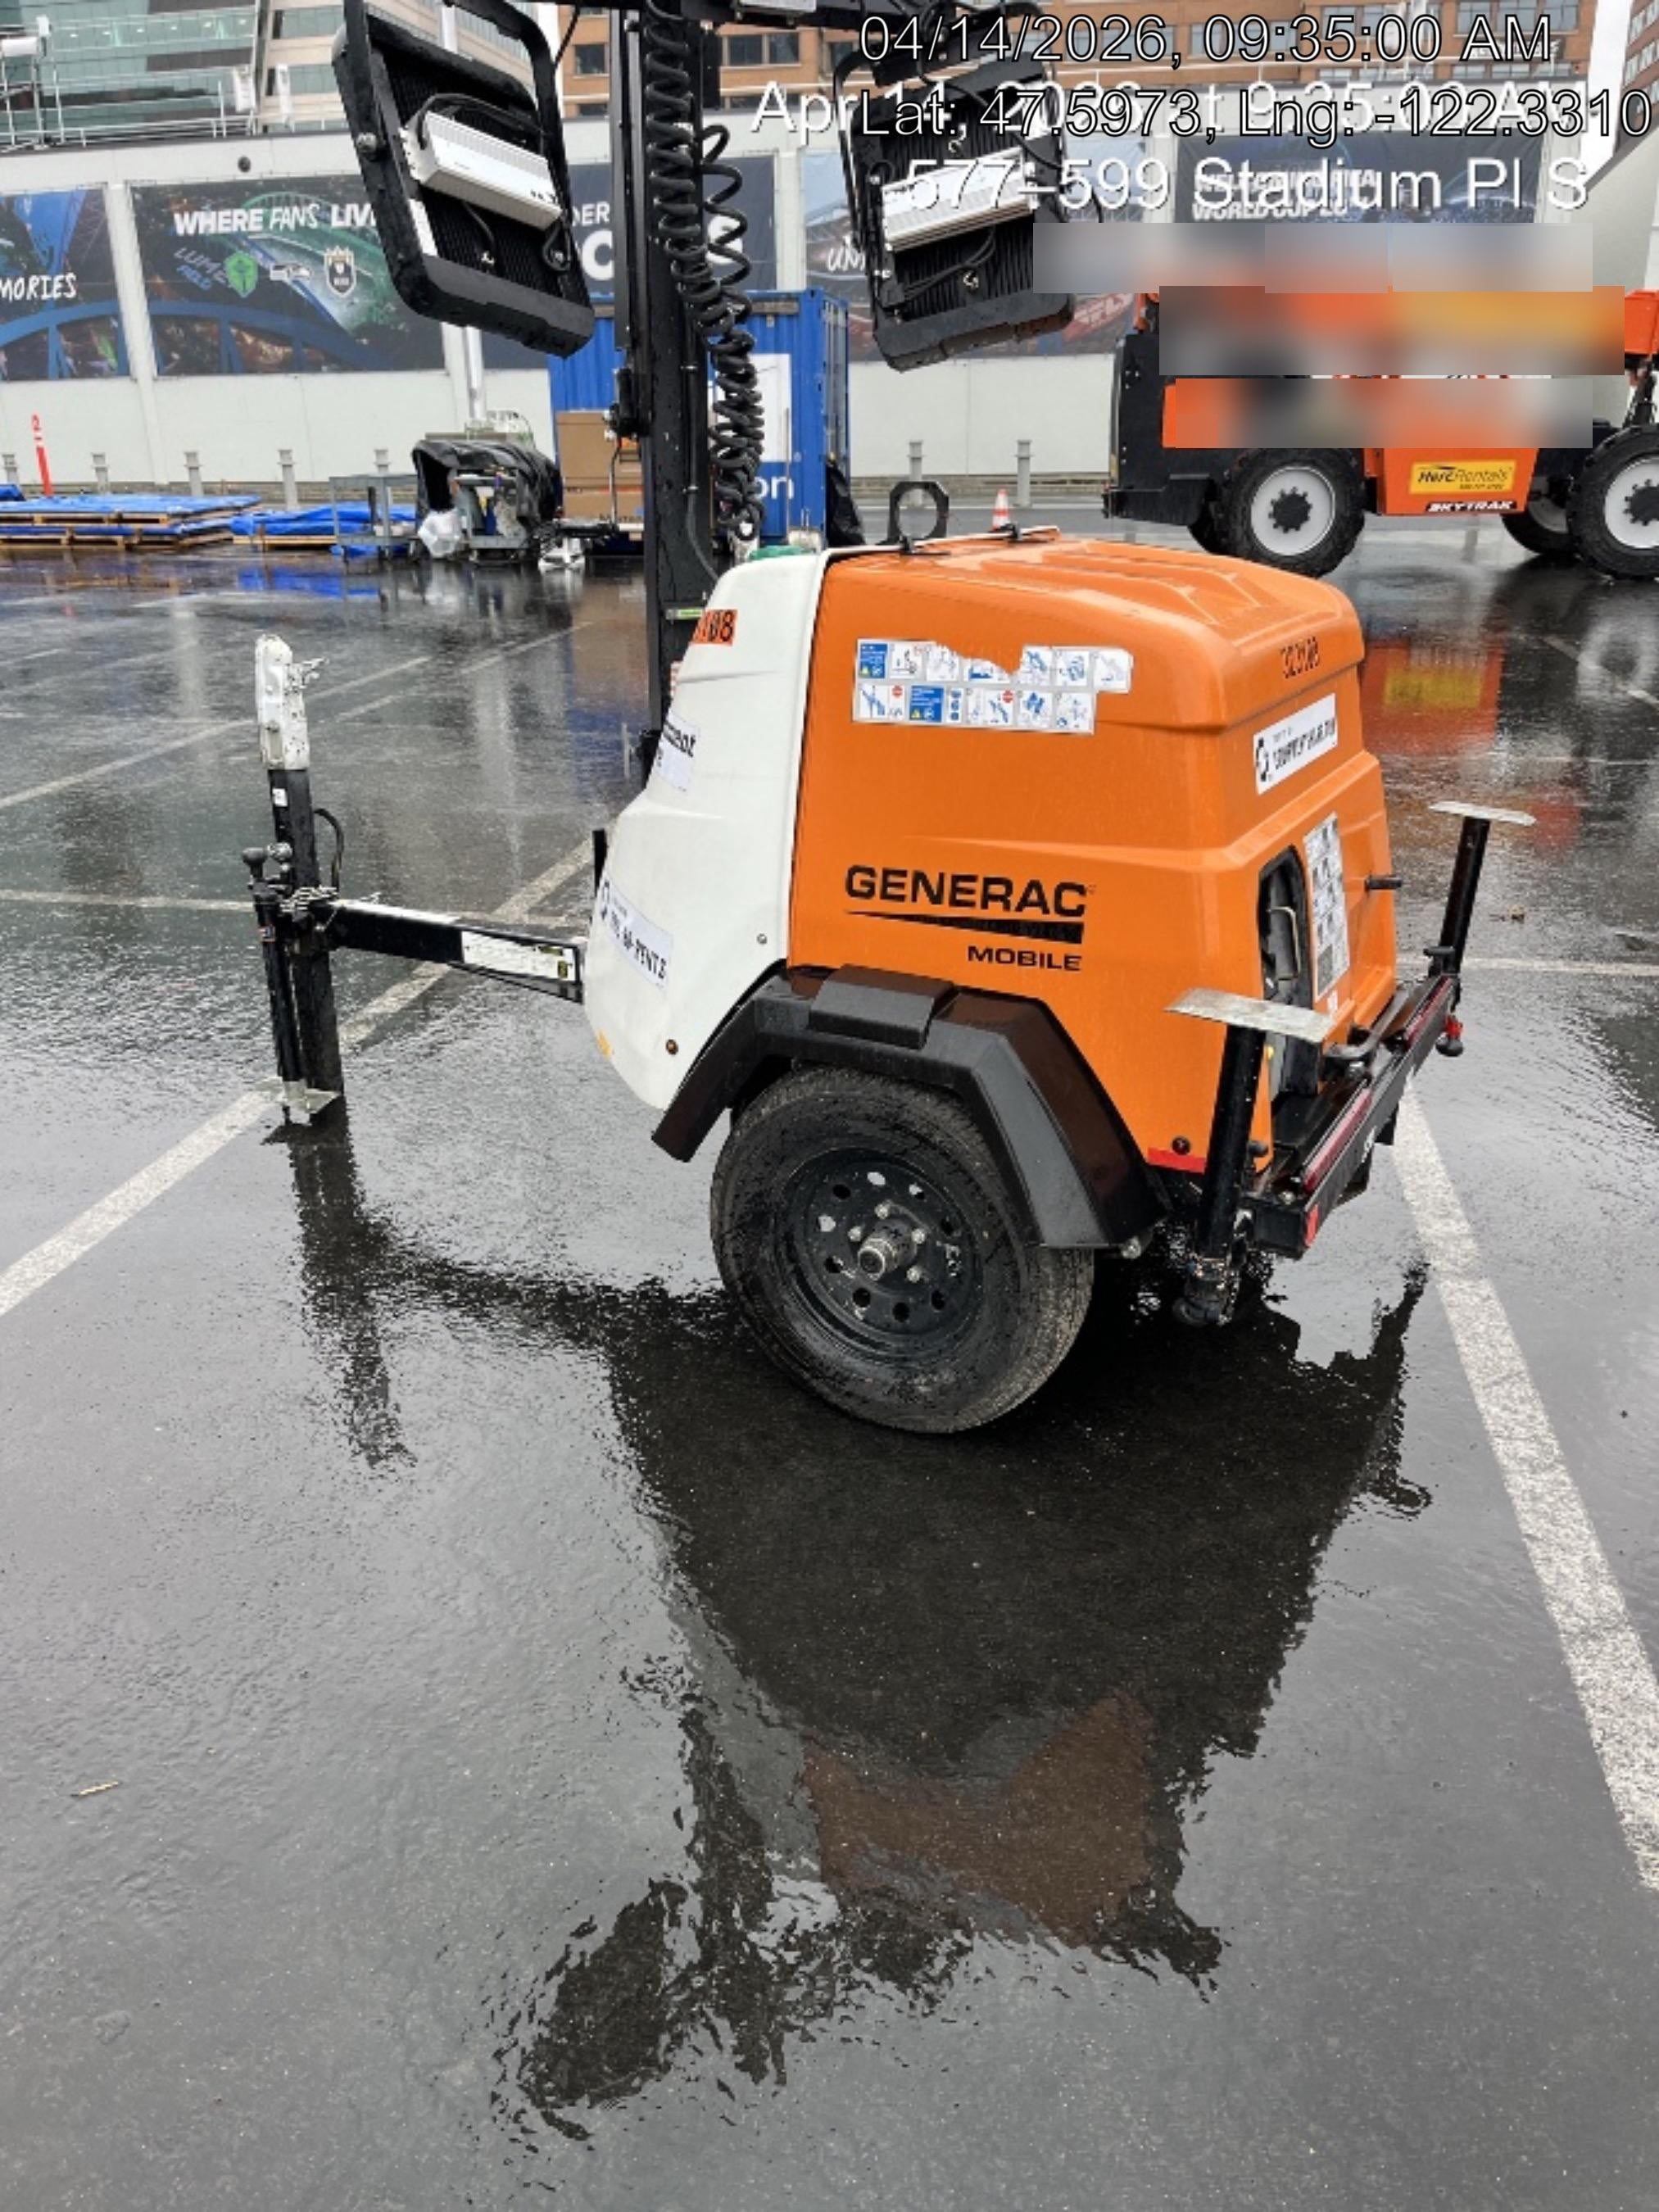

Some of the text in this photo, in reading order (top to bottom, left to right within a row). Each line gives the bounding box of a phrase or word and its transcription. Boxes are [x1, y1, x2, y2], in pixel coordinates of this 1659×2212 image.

[174, 202, 377, 236] WHERE FANS LIV
[1428, 500, 1513, 512] SKYTRAK
[845, 864, 1087, 918] GENERAC
[968, 945, 1082, 972] MOBILE
